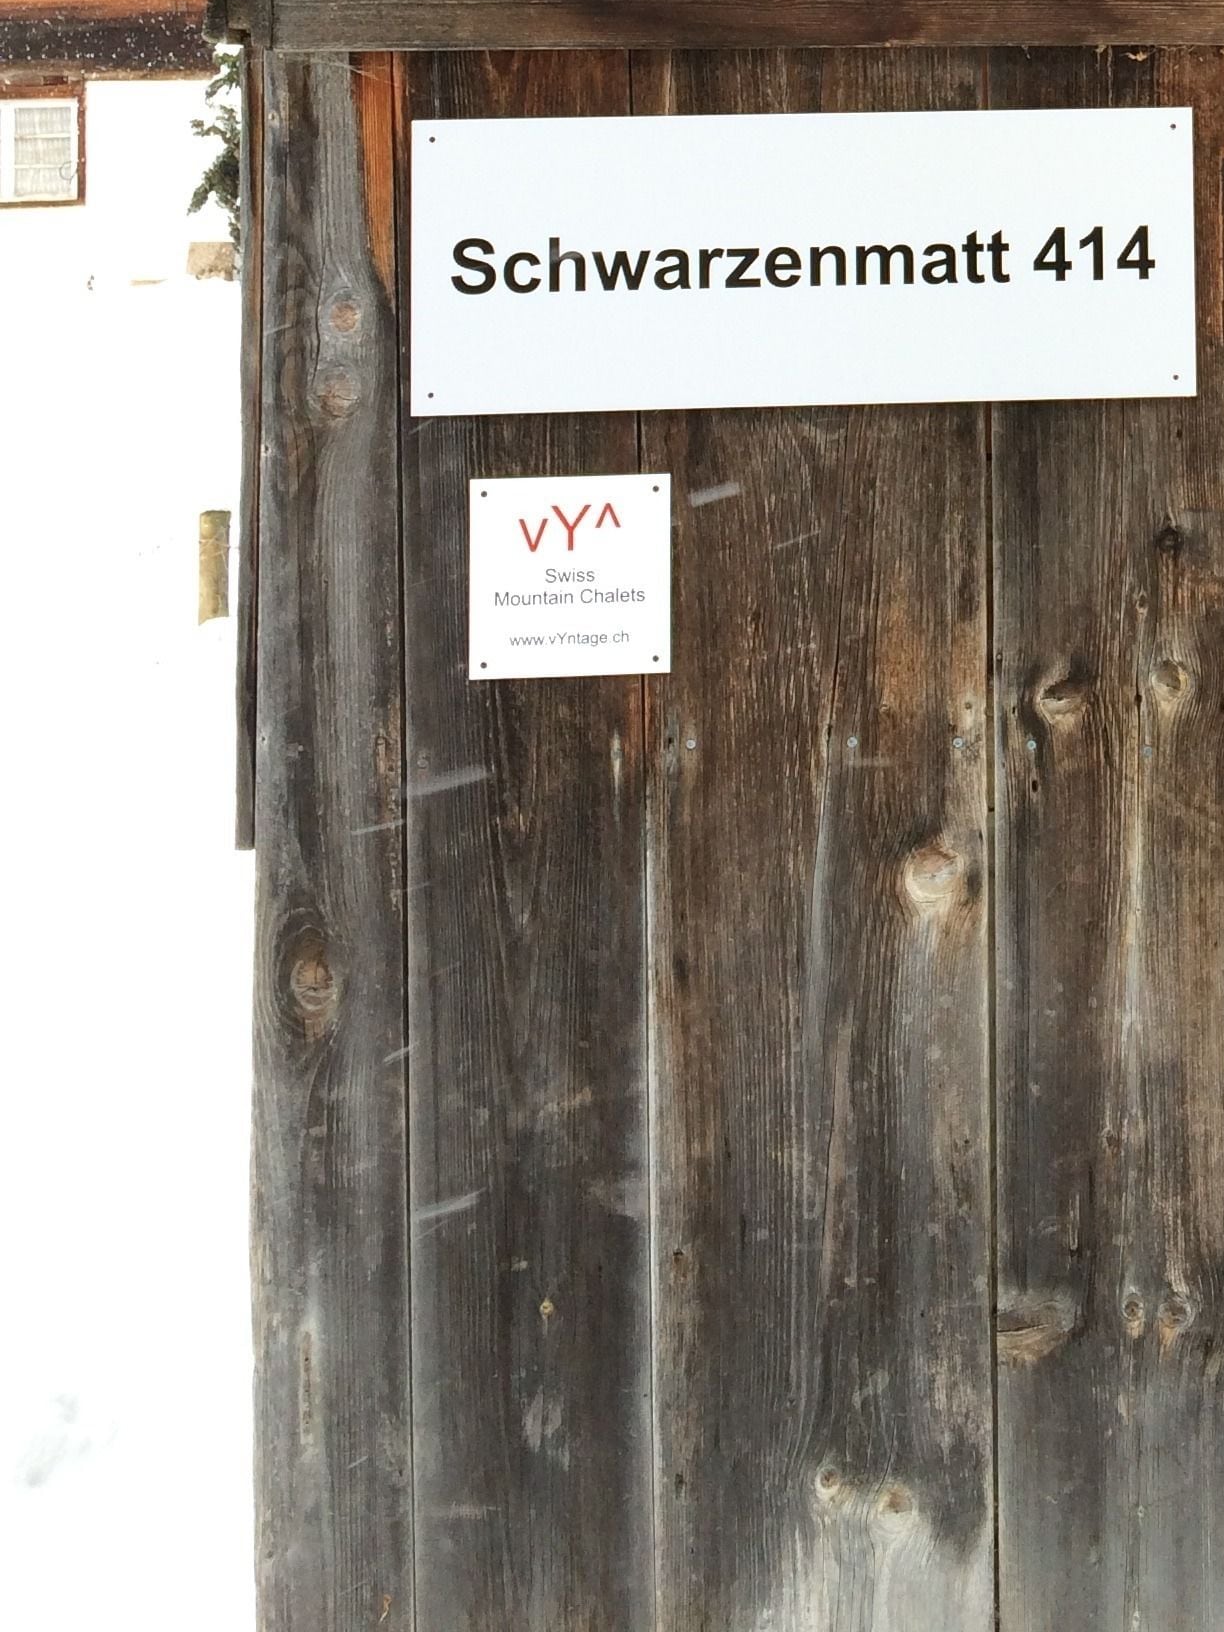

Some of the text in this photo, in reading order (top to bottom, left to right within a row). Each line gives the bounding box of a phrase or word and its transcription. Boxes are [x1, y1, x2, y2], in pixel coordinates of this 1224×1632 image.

[451, 225, 1156, 295] Schwarzenmatt 414
[545, 568, 595, 583] Swiss
[494, 587, 646, 607] Mountain Chalets
